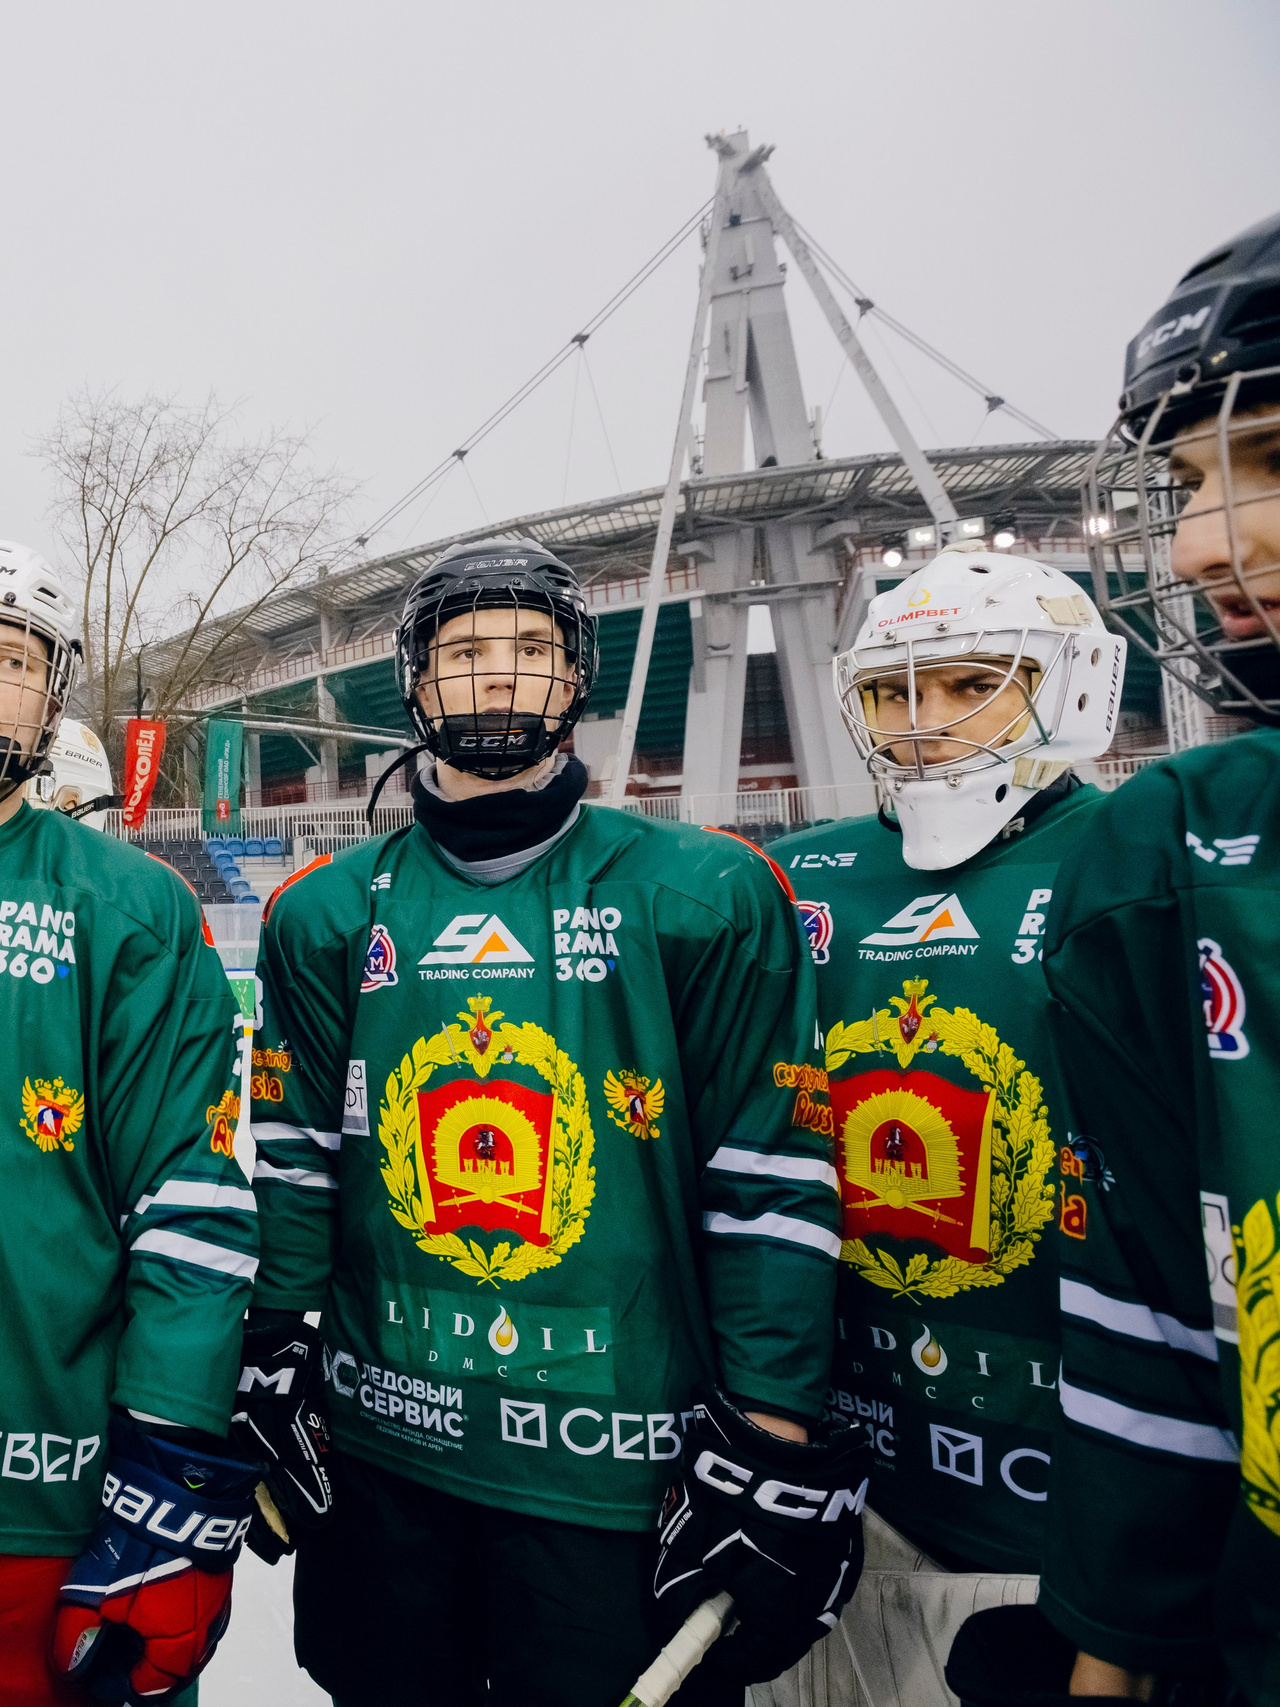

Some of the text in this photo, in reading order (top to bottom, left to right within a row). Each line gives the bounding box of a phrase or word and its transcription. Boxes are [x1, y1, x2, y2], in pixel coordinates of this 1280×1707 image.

[1137, 304, 1212, 359] CCM
[877, 607, 962, 628] OLIMPBET
[552, 906, 622, 931] PANO
[554, 930, 621, 956] RAMA
[857, 944, 979, 962] TRADING COMPANY
[418, 967, 536, 981] TRADING COMPANY
[360, 1362, 463, 1410] ЛЕДОВЫЙ
[359, 1384, 465, 1438] СЕРВИС
[693, 1449, 870, 1523] CCM
